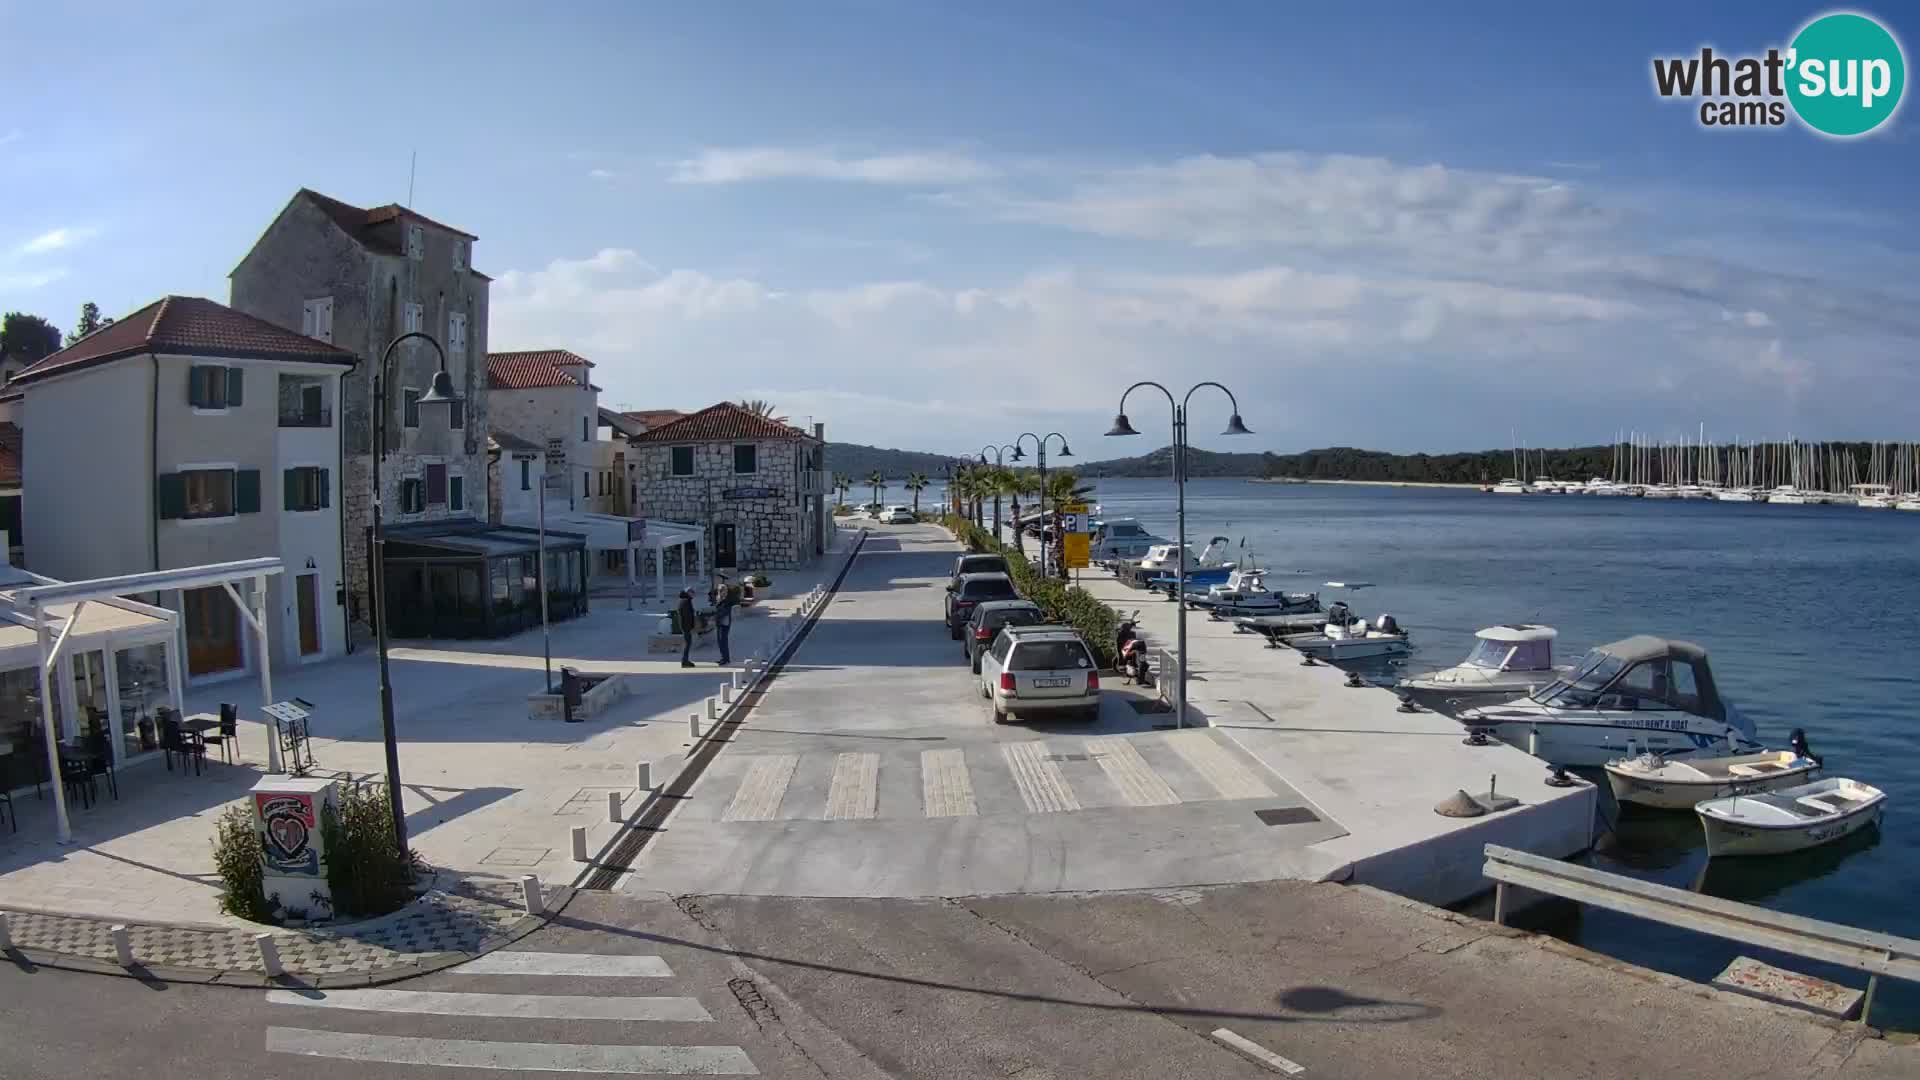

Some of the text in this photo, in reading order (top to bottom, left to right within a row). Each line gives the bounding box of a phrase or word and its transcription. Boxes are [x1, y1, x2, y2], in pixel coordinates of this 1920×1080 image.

[1066, 515, 1076, 530] P
[1645, 719, 1664, 729] RENT
[1671, 720, 1689, 730] BOAT
